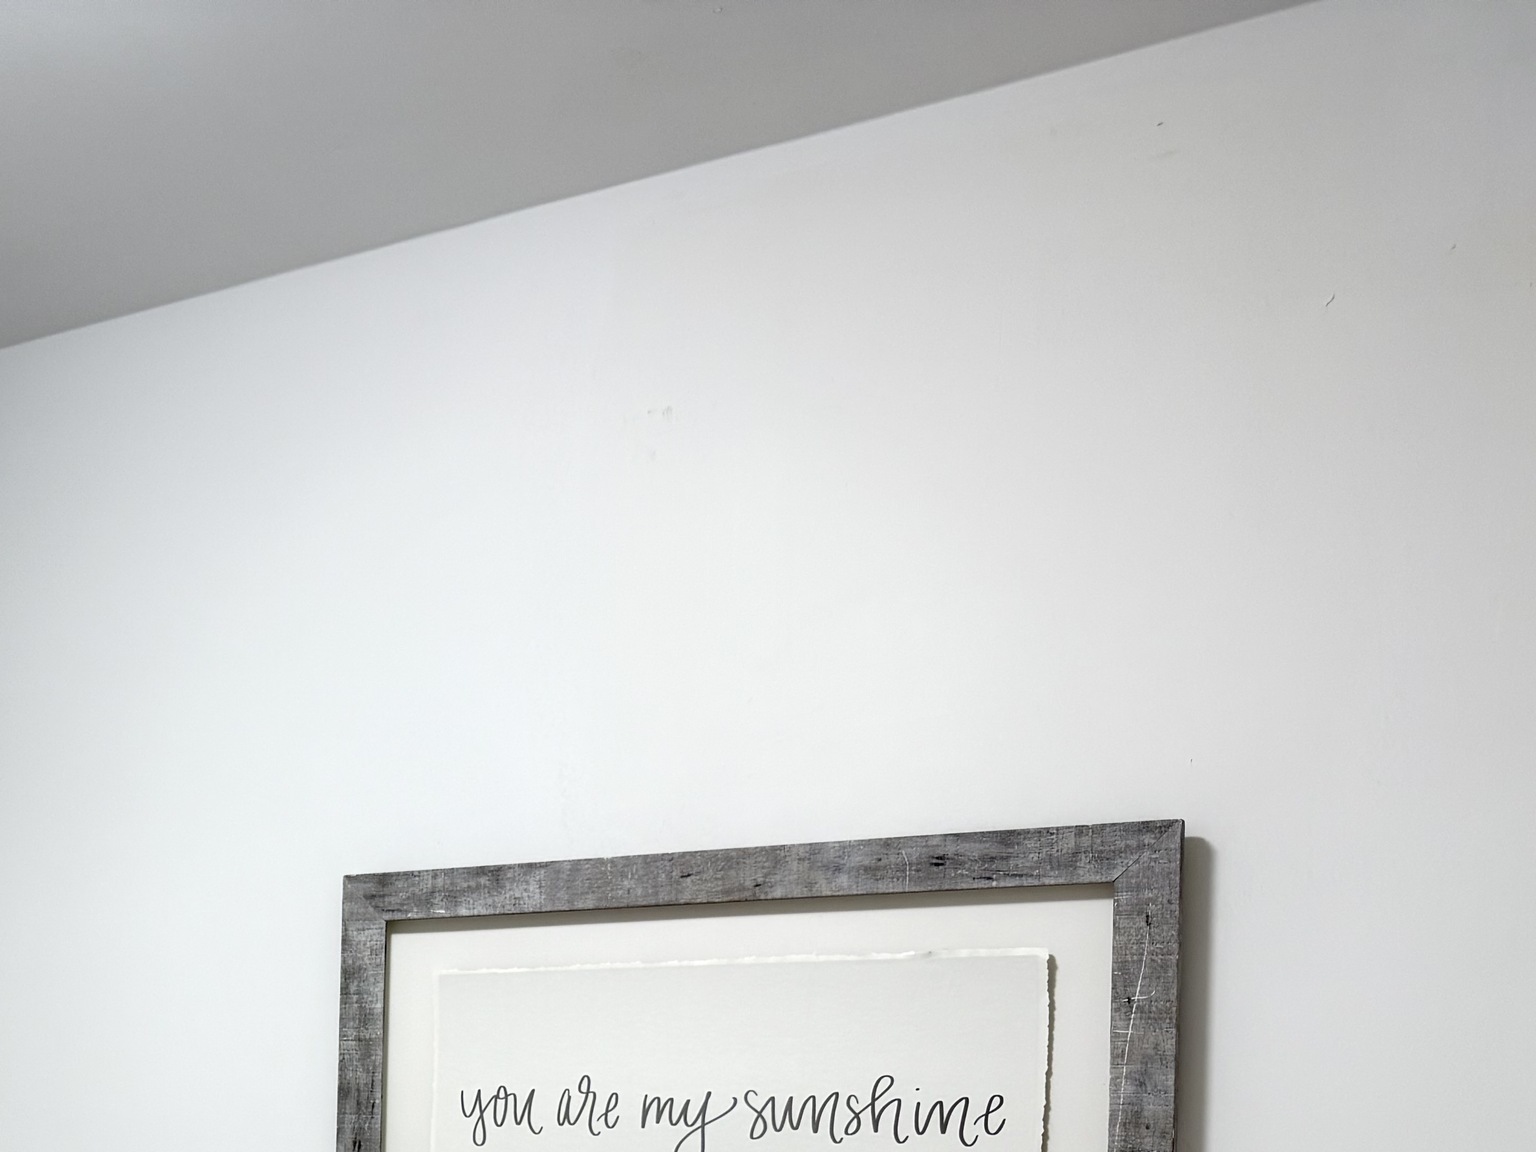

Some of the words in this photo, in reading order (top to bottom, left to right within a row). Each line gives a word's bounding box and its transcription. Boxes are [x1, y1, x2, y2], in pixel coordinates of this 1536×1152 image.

[460, 1085, 544, 1147] you
[556, 1074, 621, 1137] are
[743, 1074, 1007, 1148] sunshine
